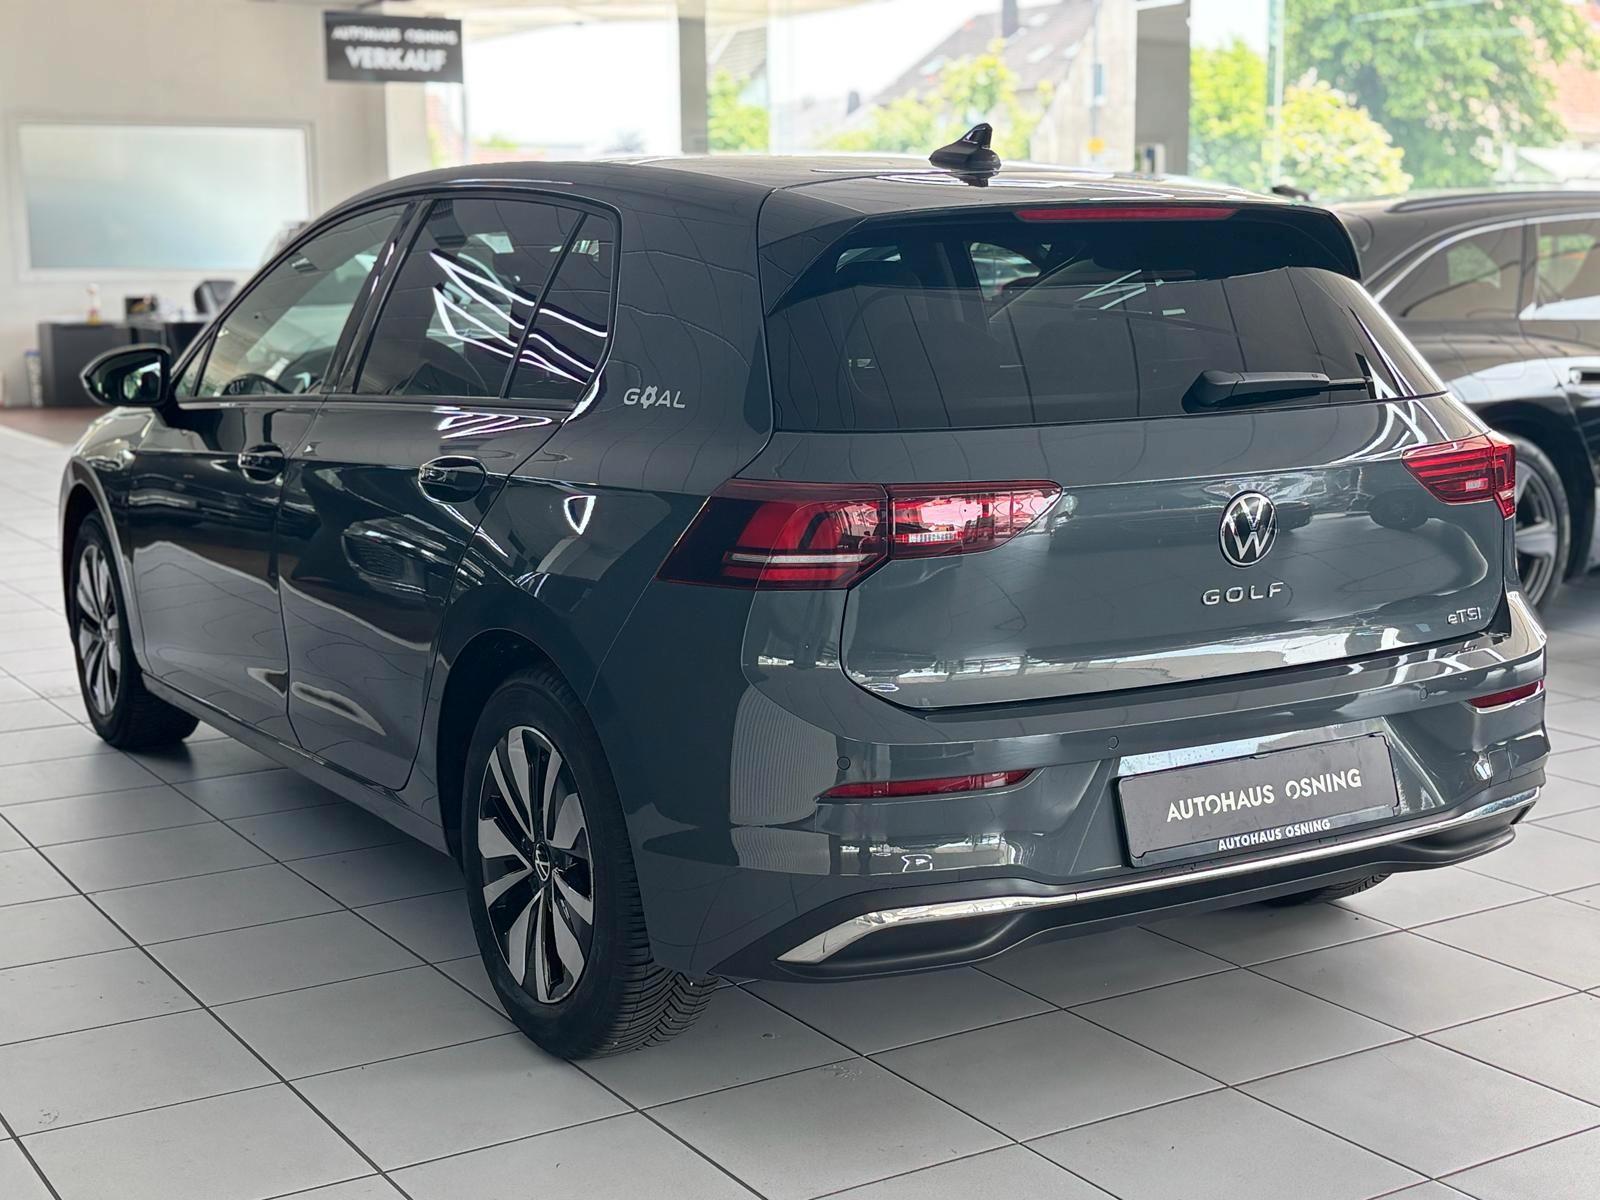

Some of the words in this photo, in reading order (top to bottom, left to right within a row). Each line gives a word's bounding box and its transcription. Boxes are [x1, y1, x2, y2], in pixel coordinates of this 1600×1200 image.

[344, 46, 447, 72] VERKAUF
[623, 385, 686, 409] GOAL
[1220, 493, 1277, 565] VW
[1202, 581, 1284, 605] GOLF
[1447, 606, 1482, 624] eTSI
[1166, 784, 1275, 823] AUTOHAUS
[1285, 768, 1362, 800] OSNING
[1218, 828, 1282, 851] AUTOHAUS
[1285, 818, 1331, 838] OSNING
